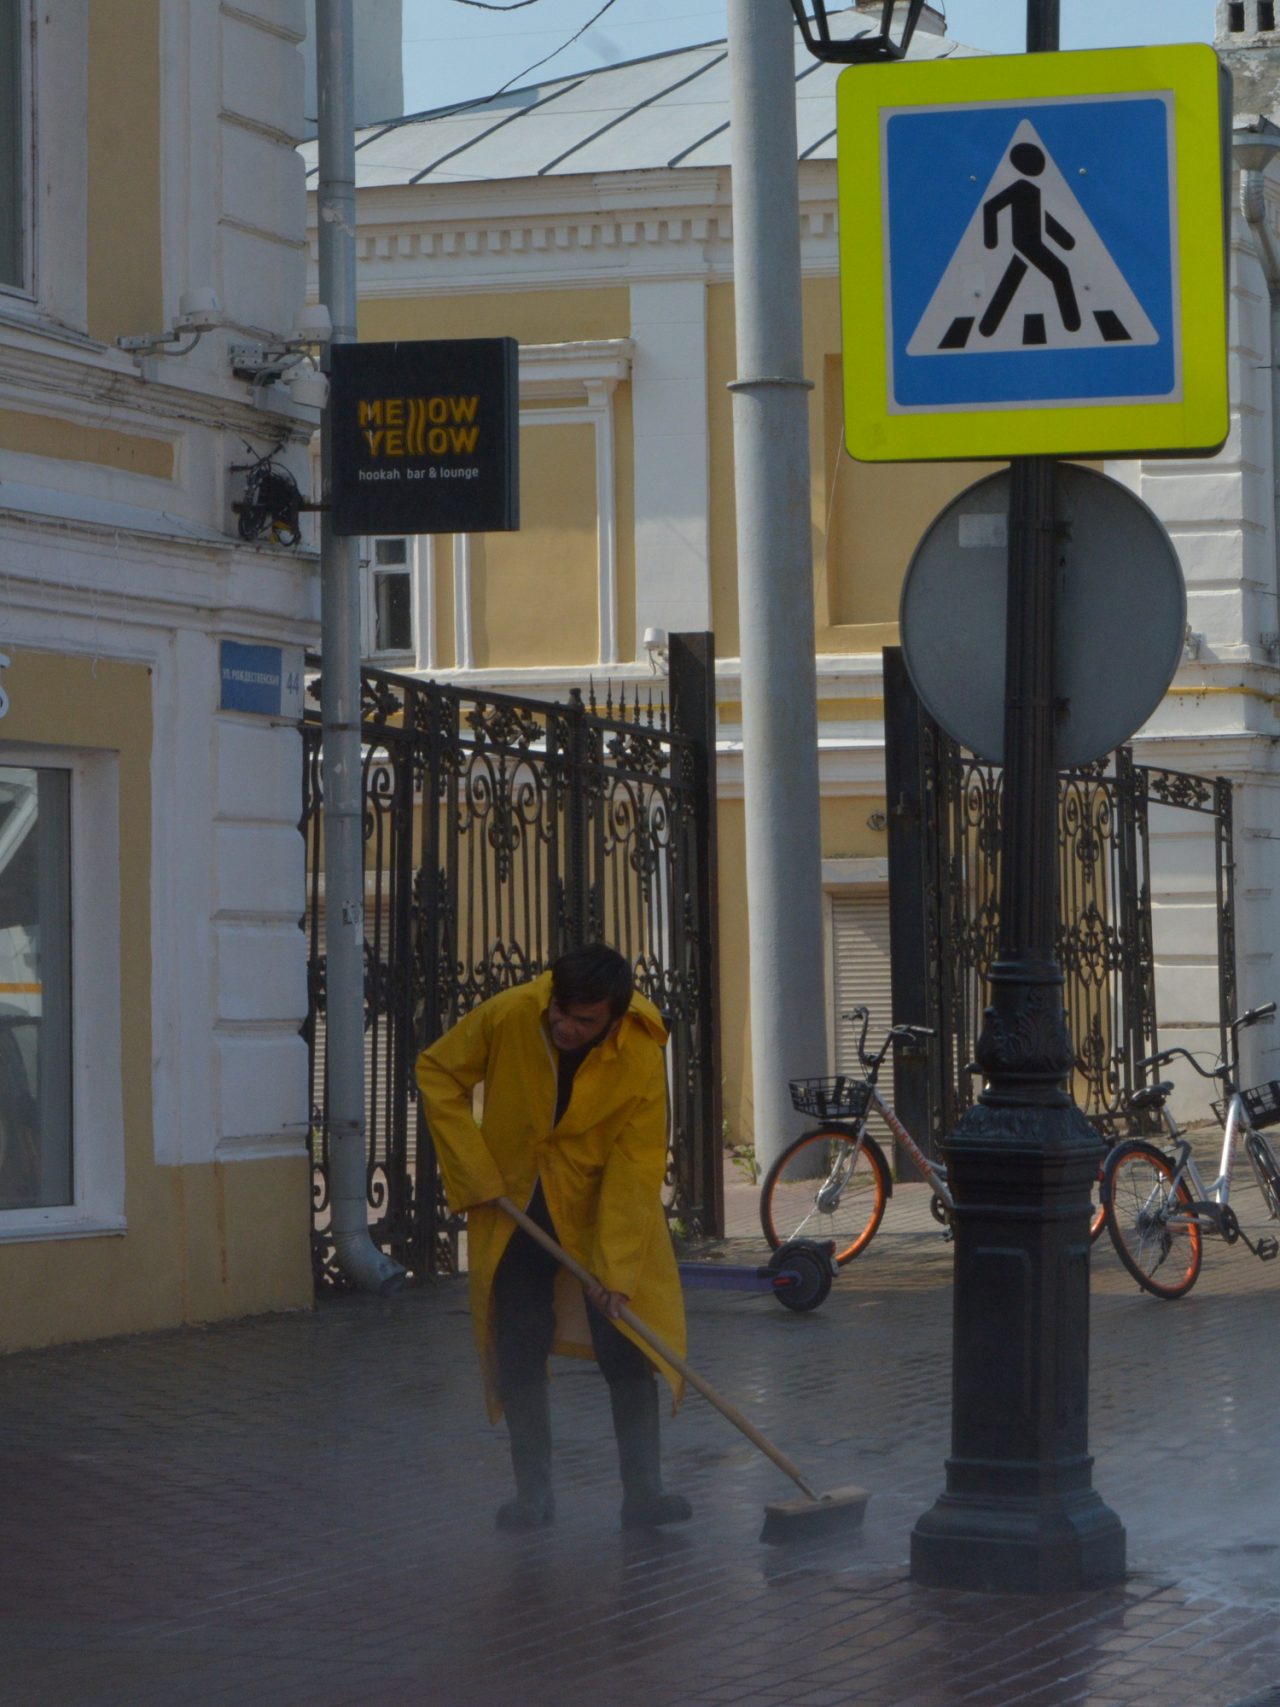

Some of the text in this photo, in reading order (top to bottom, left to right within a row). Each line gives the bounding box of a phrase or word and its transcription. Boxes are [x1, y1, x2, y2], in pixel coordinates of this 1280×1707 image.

[358, 466, 479, 481] hookah bar & lounge
[286, 672, 300, 695] 44
